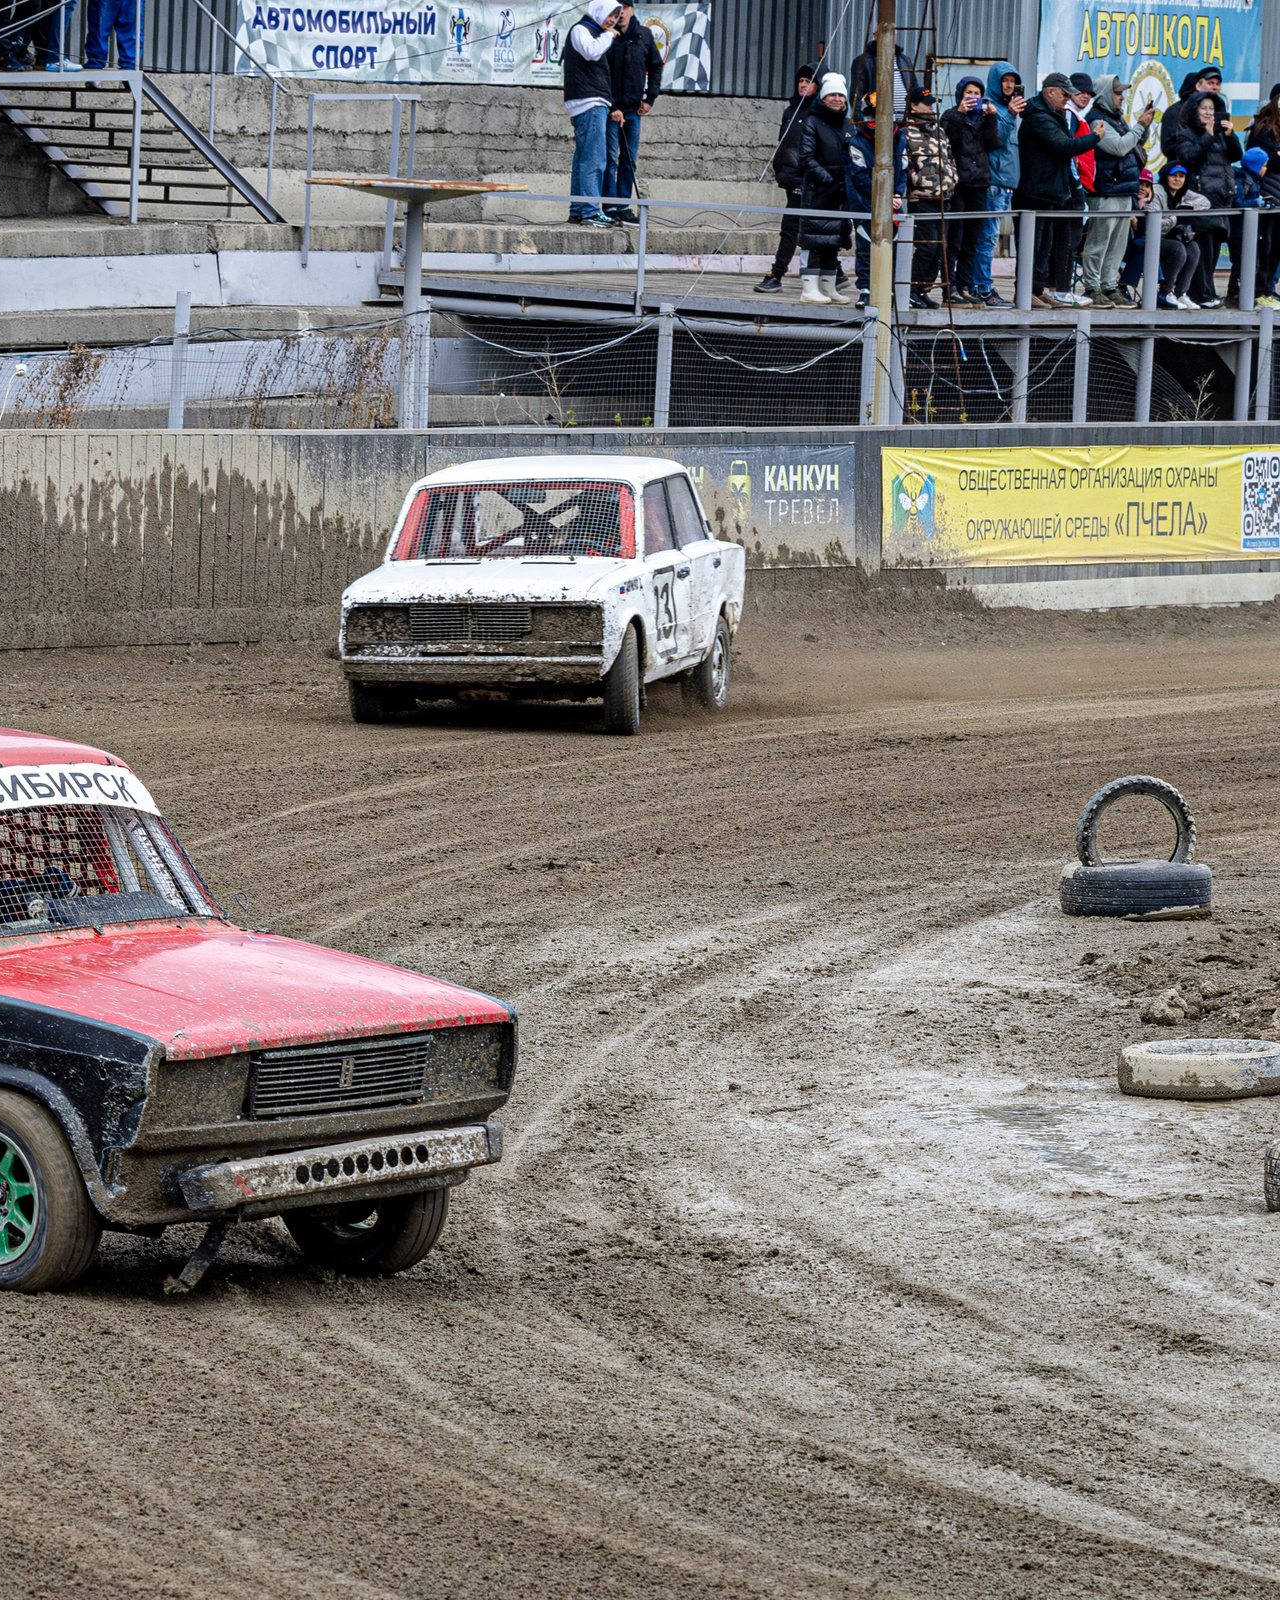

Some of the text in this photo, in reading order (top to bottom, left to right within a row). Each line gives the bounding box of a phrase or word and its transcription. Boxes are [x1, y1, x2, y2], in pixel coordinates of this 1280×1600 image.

[251, 5, 436, 36] АВТОМОБИЛЬНЫЙ
[1077, 10, 1224, 67] АВТОШКОЛА
[312, 44, 378, 70] СПОРТ
[764, 464, 840, 492] КАНКУН
[958, 466, 1218, 495] ОБЩЕСТВЕННАЯ ОРГАНИЗАЦИЯ ОХРАНЫ
[764, 498, 839, 525] ТРЕВЕЛ
[966, 501, 1208, 544] ОКРУЖАЮЩЕЙ СРЕДЫ «ПЧЕЛА»
[653, 582, 673, 641] 13
